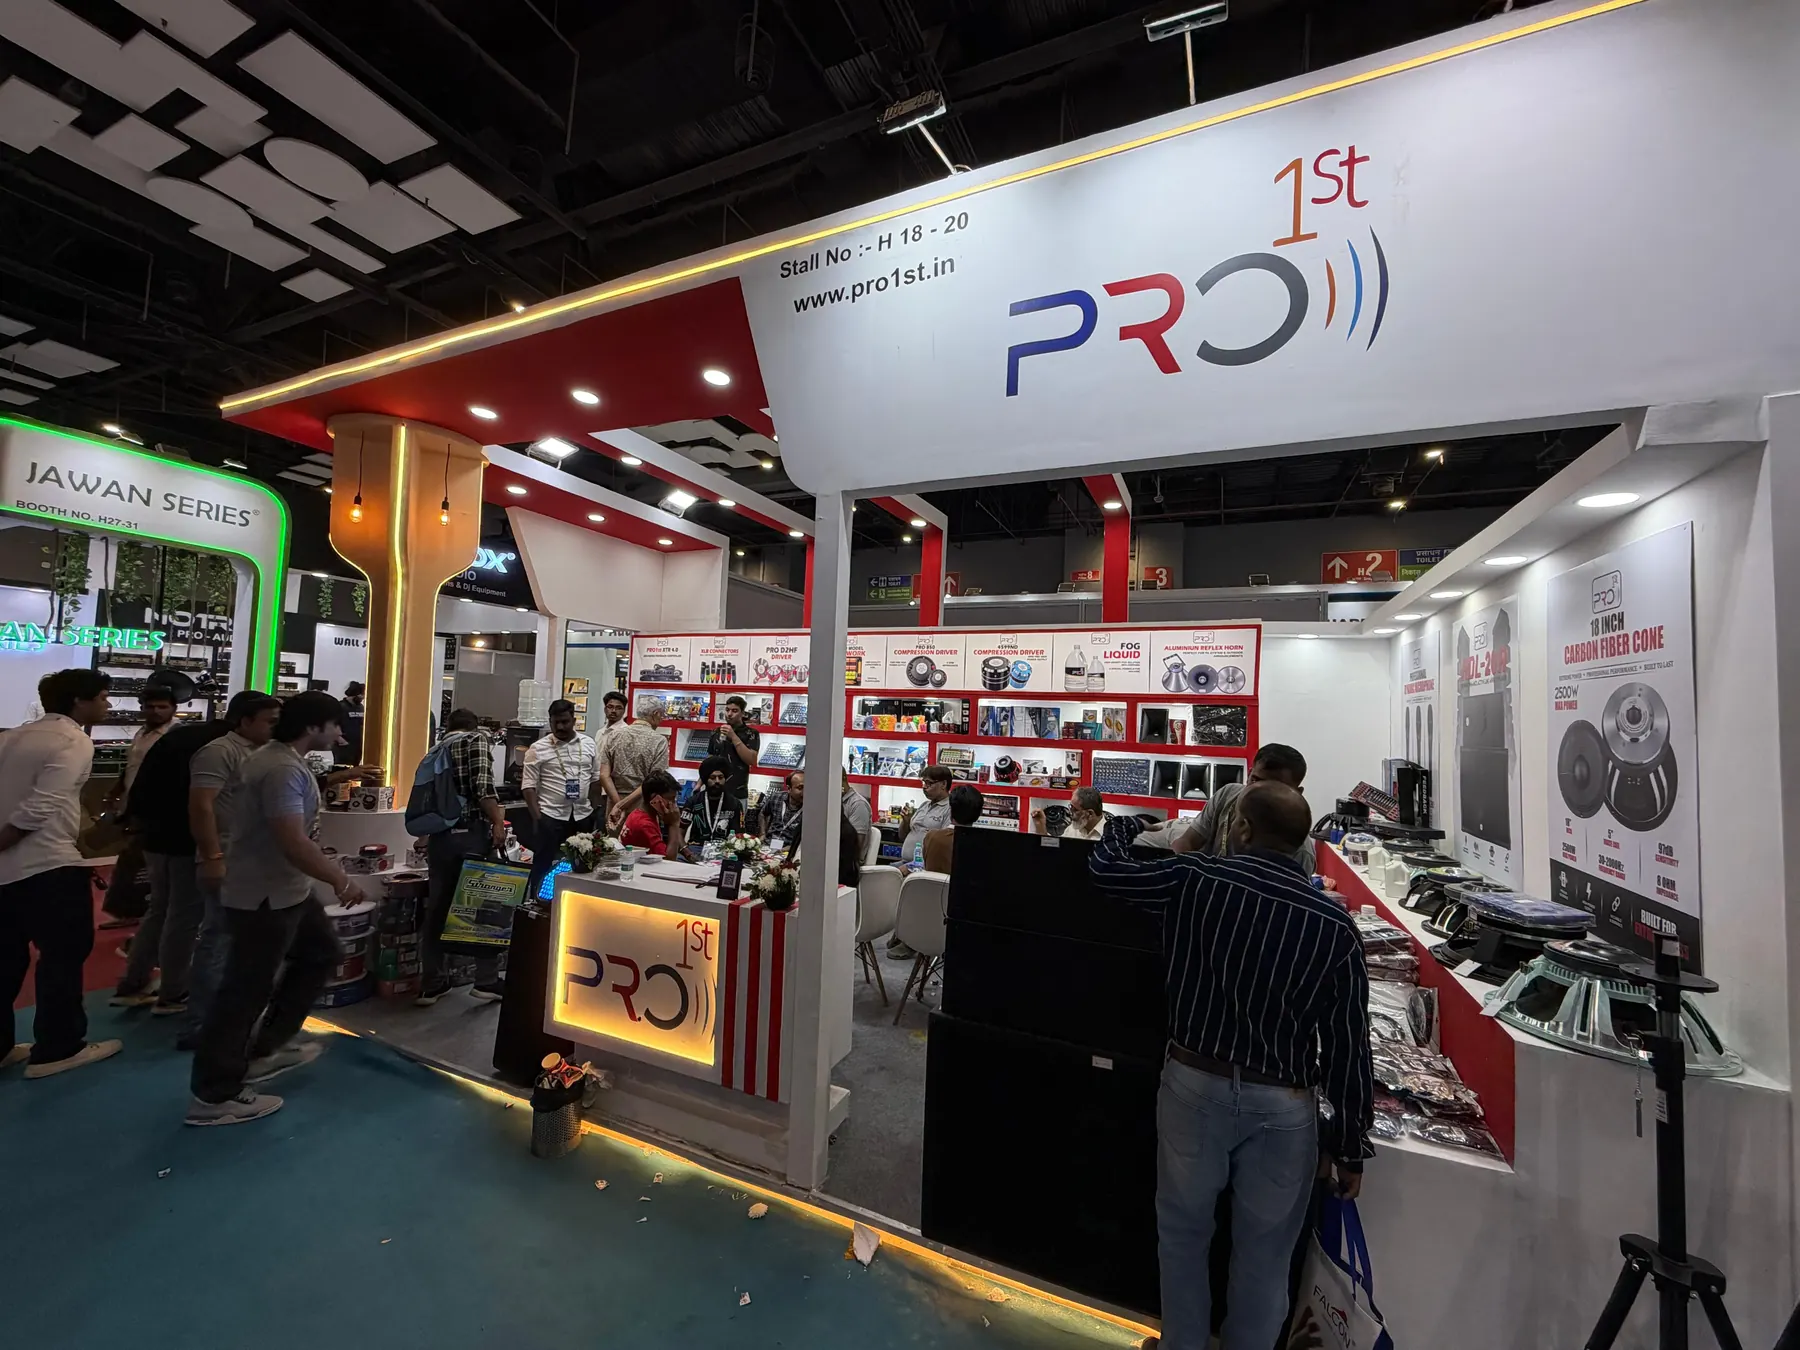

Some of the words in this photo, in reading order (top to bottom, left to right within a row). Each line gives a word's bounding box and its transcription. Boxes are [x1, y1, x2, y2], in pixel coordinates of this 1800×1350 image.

[1272, 144, 1371, 248] 1st
[780, 252, 819, 278] Stall
[826, 246, 851, 266] No
[878, 232, 892, 251] H
[900, 224, 923, 245] 18
[943, 211, 969, 234] 20
[793, 256, 955, 313] www.pro1st.in
[1005, 251, 1310, 398] PRO
[26, 461, 153, 507] JAWAN
[16, 499, 68, 517] BOOTH
[71, 509, 95, 522] NO.
[98, 515, 139, 530] H27-31
[1087, 570, 1093, 580] 8
[1155, 567, 1168, 586] 3
[471, 585, 506, 598] Equipment
[1593, 588, 1615, 609] PRO
[177, 629, 203, 640] PRO
[1590, 617, 1599, 637] 18
[1601, 611, 1625, 635] INCH
[62, 625, 167, 651] SERIES
[334, 636, 360, 648] WALL
[1120, 642, 1141, 650] FOG
[1564, 639, 1598, 665] CARBON
[1600, 632, 1630, 659] FIBER
[1632, 625, 1664, 653] CONE
[1103, 650, 1141, 659] LIQUID
[1555, 684, 1579, 699] 2500W
[1563, 699, 1578, 710] POWER
[1640, 909, 1661, 930] BUILT
[1662, 918, 1677, 935] FOR
[675, 918, 713, 970] 1st
[562, 945, 689, 1031] PRO
[1313, 1284, 1351, 1349] FALCON
